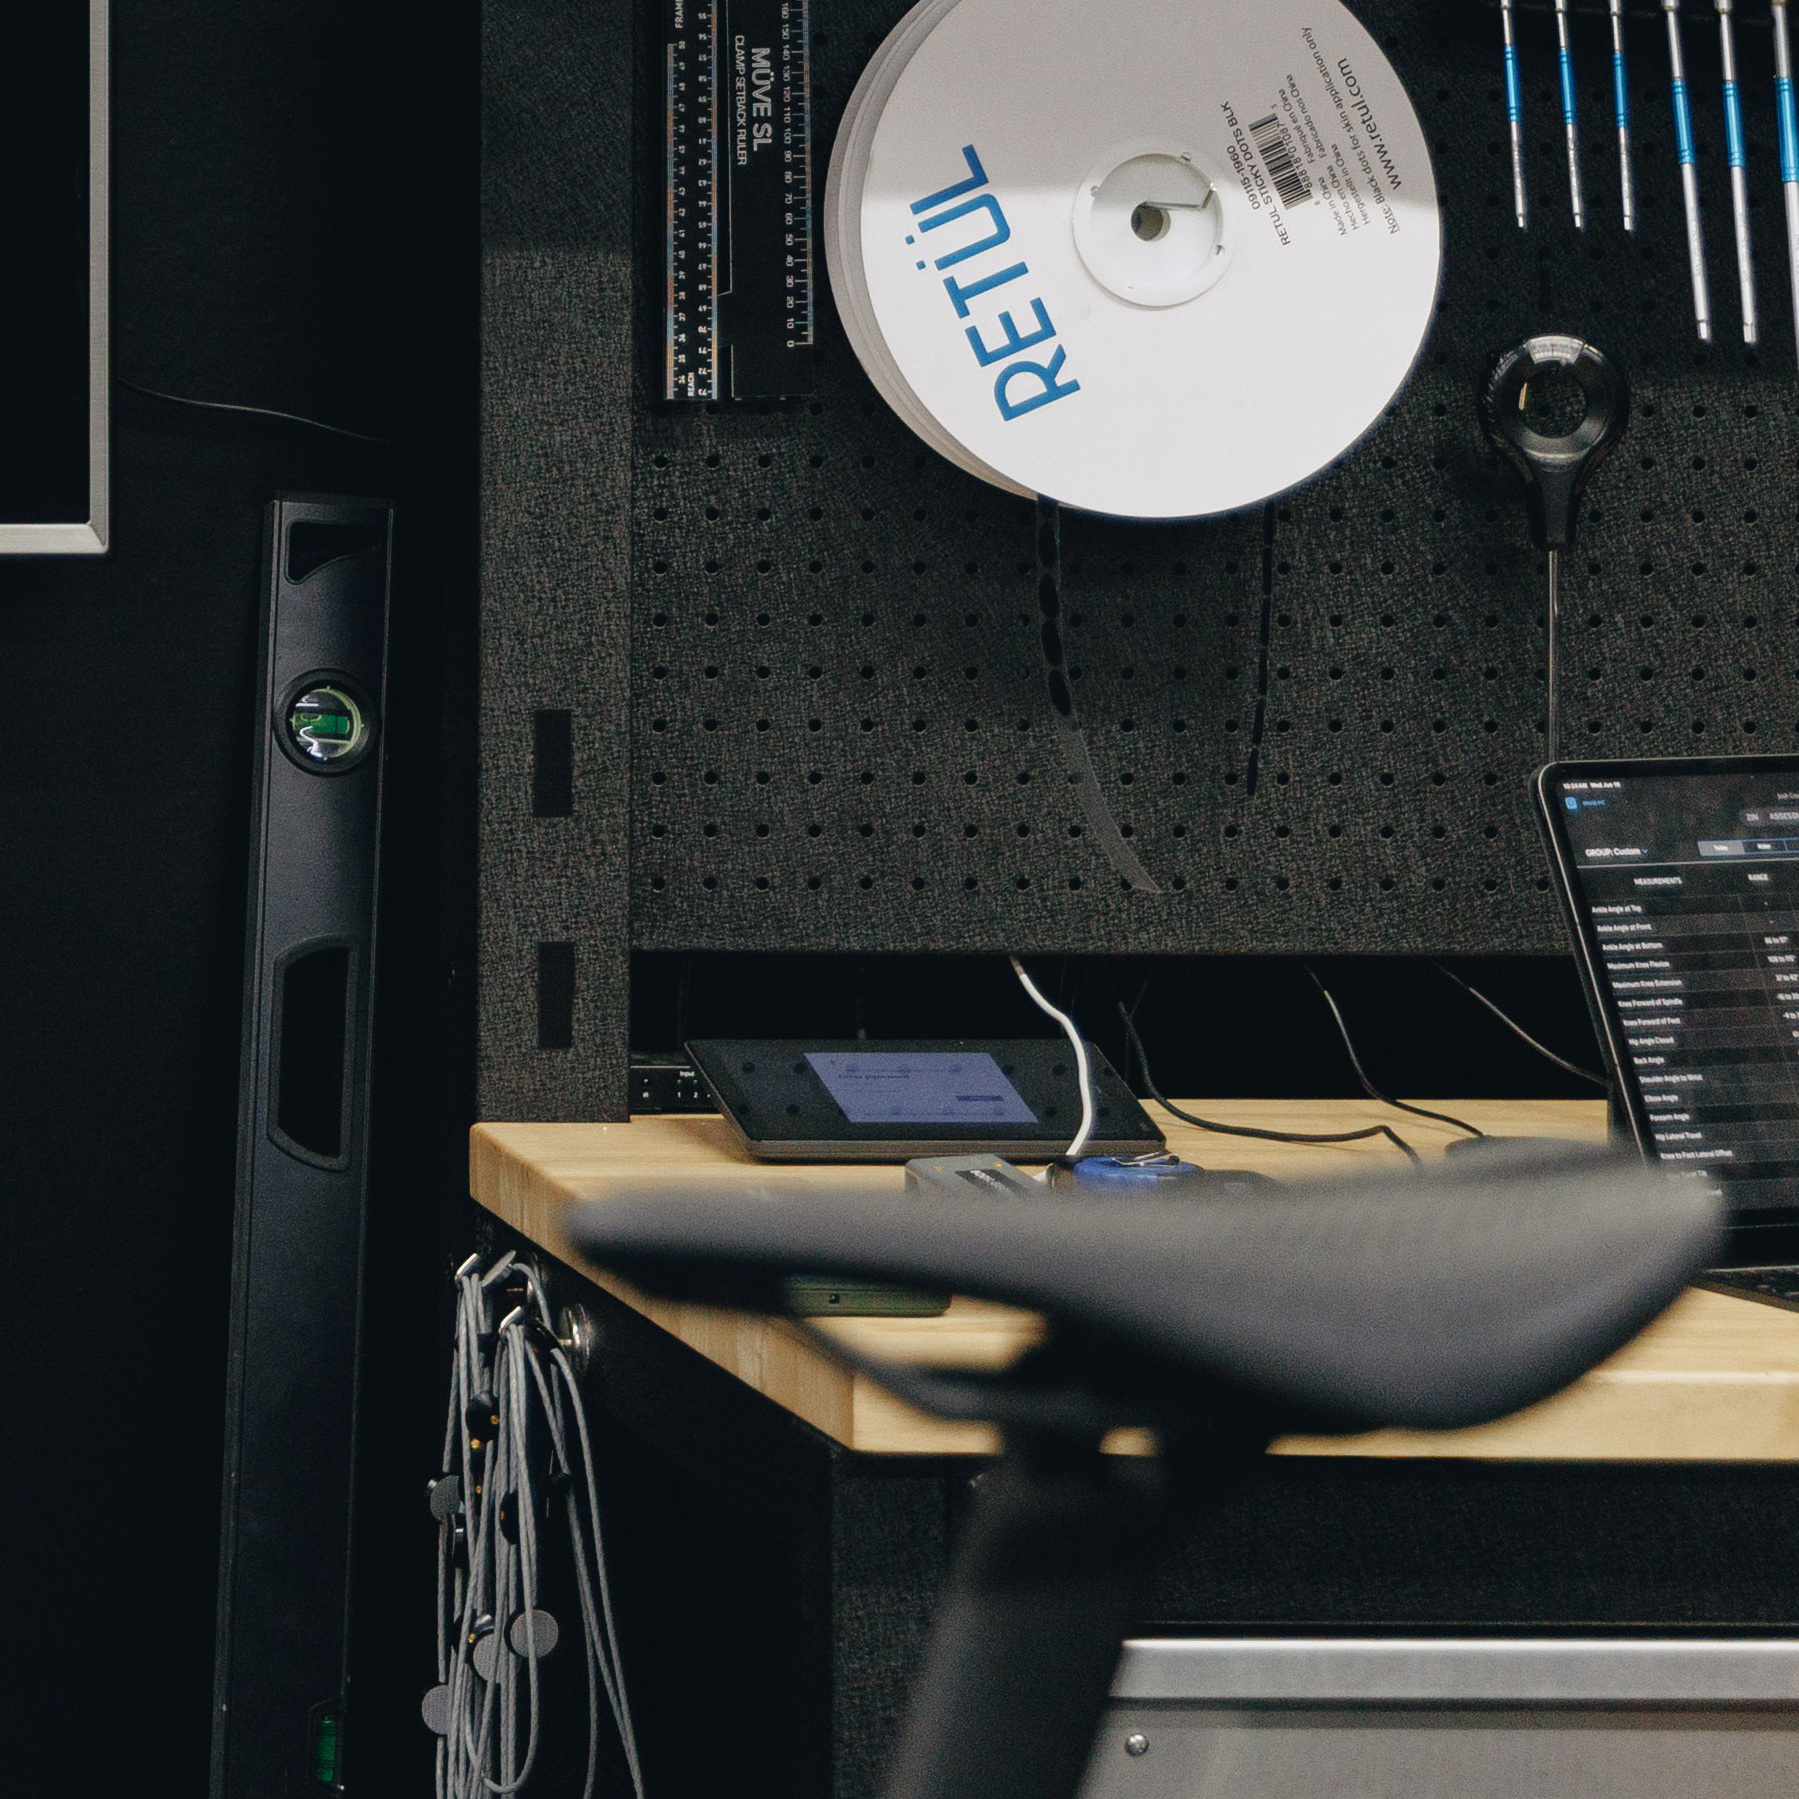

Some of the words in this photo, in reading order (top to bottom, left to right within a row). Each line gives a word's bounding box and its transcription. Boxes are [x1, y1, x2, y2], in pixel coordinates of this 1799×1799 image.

[1301, 27, 1317, 50] only
[734, 35, 746, 75] CLAMP
[752, 47, 775, 117] MÜVE
[1286, 74, 1300, 98] China
[1312, 51, 1343, 109] application
[735, 76, 747, 126] SETBACK
[1220, 100, 1238, 127] BLK
[1278, 88, 1292, 112] China
[1296, 97, 1308, 114] nos
[1288, 111, 1298, 124] en
[1337, 57, 1401, 190] www.retul.com
[1339, 110, 1353, 133] skin
[737, 129, 748, 165] RULER
[752, 122, 773, 152] SL
[1232, 127, 1253, 161] DOTS
[1292, 124, 1315, 164] Fabriqué
[1304, 114, 1327, 158] Fabricado
[1349, 134, 1361, 150] for
[1331, 143, 1345, 167] China
[1356, 150, 1372, 174] dots
[1226, 145, 1260, 209] 09115-1960
[1247, 164, 1272, 205] STICKY
[1326, 165, 1340, 189] China
[1341, 166, 1349, 177] in
[1317, 176, 1331, 200] China
[1336, 188, 1346, 200] en
[1345, 177, 1370, 225] Hergestellt
[1366, 175, 1385, 204] Black
[1328, 199, 1336, 209] in
[1342, 200, 1359, 230] Hecho
[1382, 203, 1400, 234] Note:
[1269, 205, 1291, 245] RETUL
[1333, 210, 1347, 236] Made
[905, 144, 1081, 422] RETÜL
